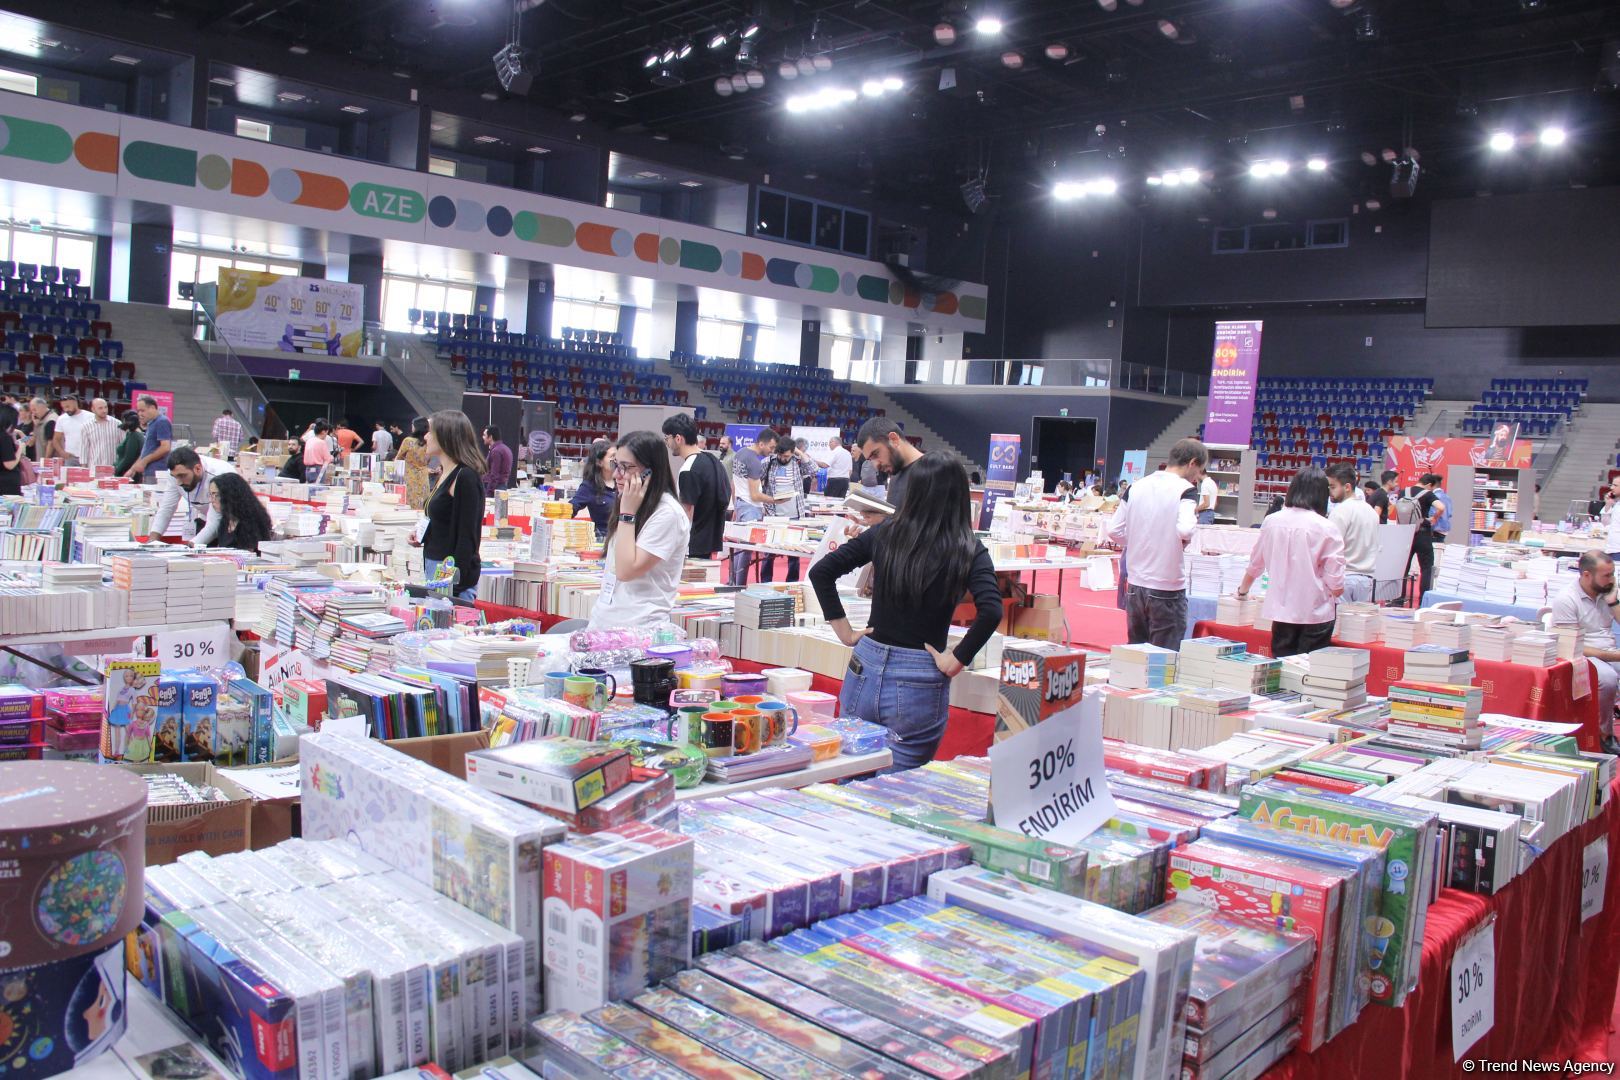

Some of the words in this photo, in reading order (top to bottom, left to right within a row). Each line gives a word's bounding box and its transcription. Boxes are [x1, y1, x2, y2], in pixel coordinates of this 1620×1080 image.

[363, 190, 412, 218] AZE
[1212, 368, 1246, 377] ENDİRİM
[173, 643, 194, 659] 30
[199, 640, 214, 656] %
[1003, 661, 1036, 685] Jenga
[1045, 661, 1079, 700] Jenga
[159, 686, 177, 700] enga
[191, 686, 212, 701] Jenga
[1029, 738, 1075, 790] 30%
[1019, 777, 1095, 838] ENDİRİM
[1252, 799, 1395, 849] ACTIVITY
[1458, 968, 1470, 1003] 30
[1472, 962, 1483, 991] %
[1461, 1009, 1483, 1037] ENDİRİM
